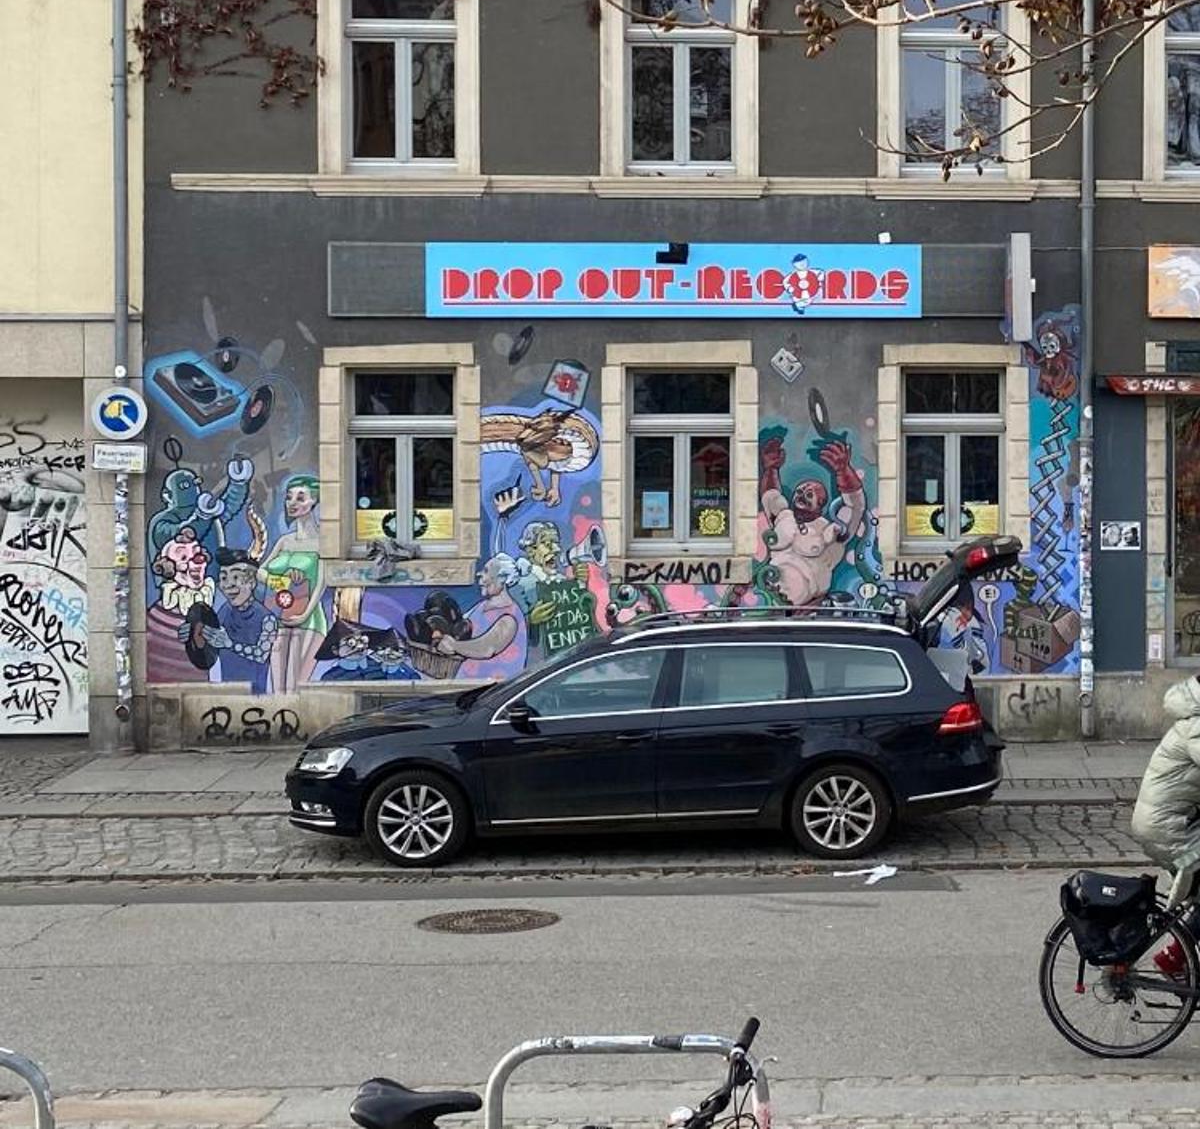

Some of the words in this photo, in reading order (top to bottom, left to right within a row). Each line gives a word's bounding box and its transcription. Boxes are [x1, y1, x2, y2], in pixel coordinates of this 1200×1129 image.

[442, 267, 564, 301] DROP
[1141, 378, 1176, 392] THC
[552, 587, 580, 604] DAS
